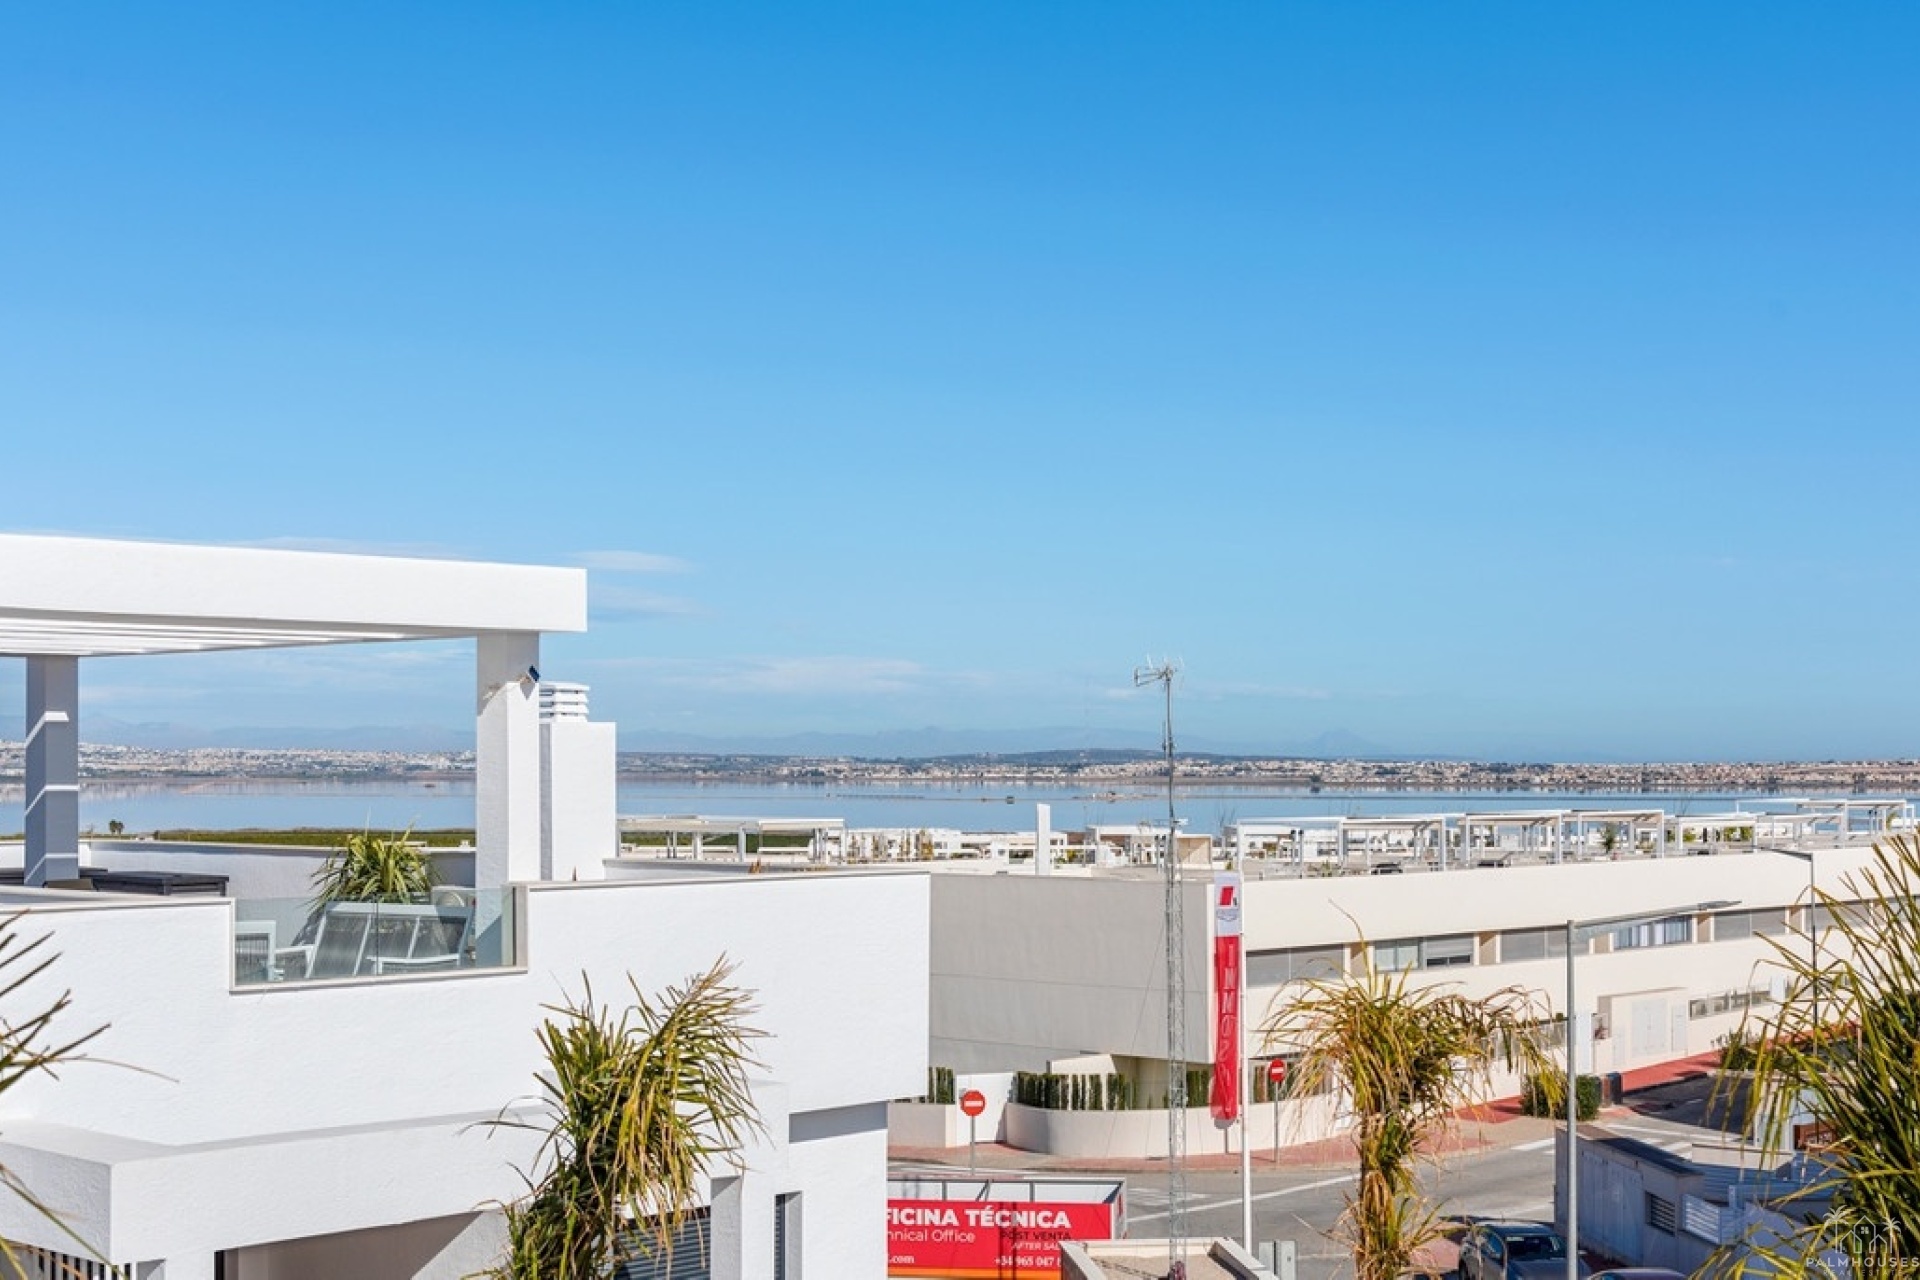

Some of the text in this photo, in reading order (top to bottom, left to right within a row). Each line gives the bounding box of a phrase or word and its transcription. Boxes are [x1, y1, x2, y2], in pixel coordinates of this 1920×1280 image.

[964, 1205, 1072, 1229] TÉCNICA
[931, 1229, 976, 1243] Office
[1034, 1231, 1072, 1240] VENTA
